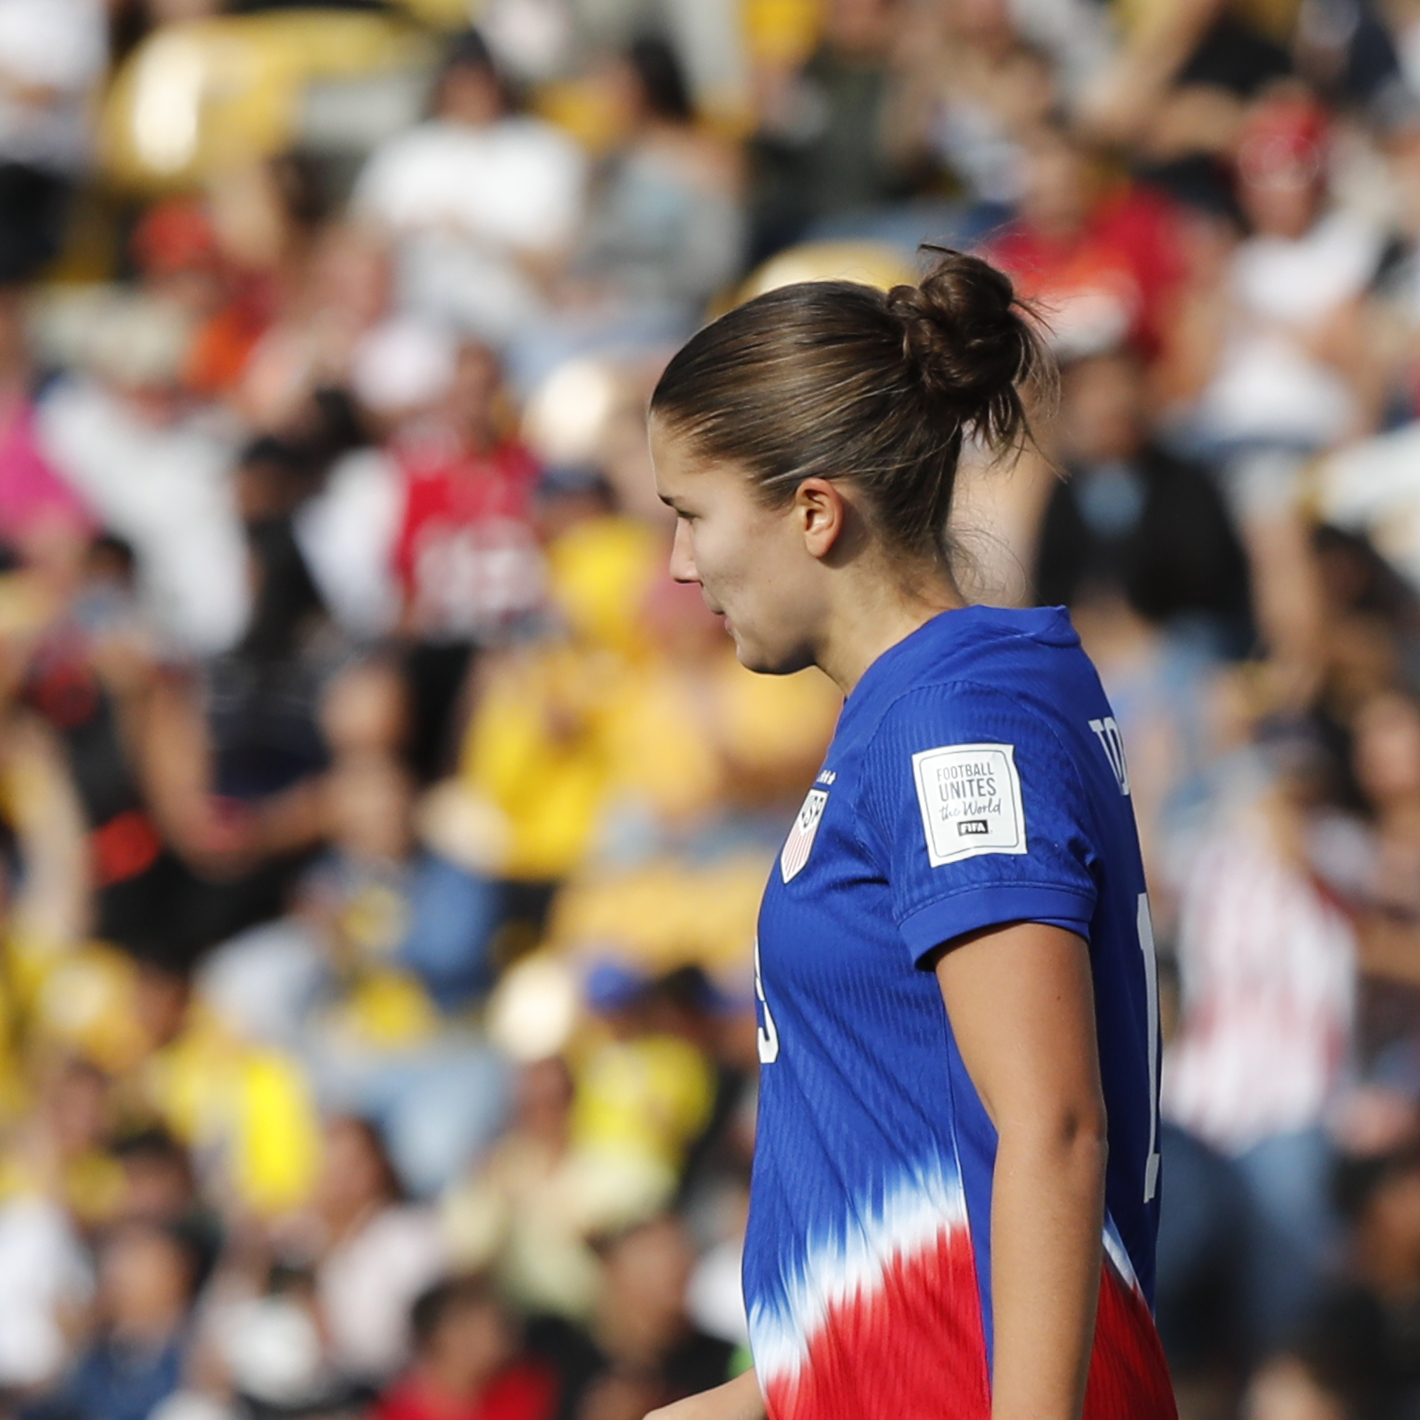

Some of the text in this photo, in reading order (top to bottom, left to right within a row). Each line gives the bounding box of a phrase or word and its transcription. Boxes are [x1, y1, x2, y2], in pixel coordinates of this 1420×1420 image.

[936, 762, 995, 782] FOOTBALL
[939, 777, 997, 802] UNITES
[939, 798, 1002, 821] the World
[959, 822, 987, 835] FIFA
